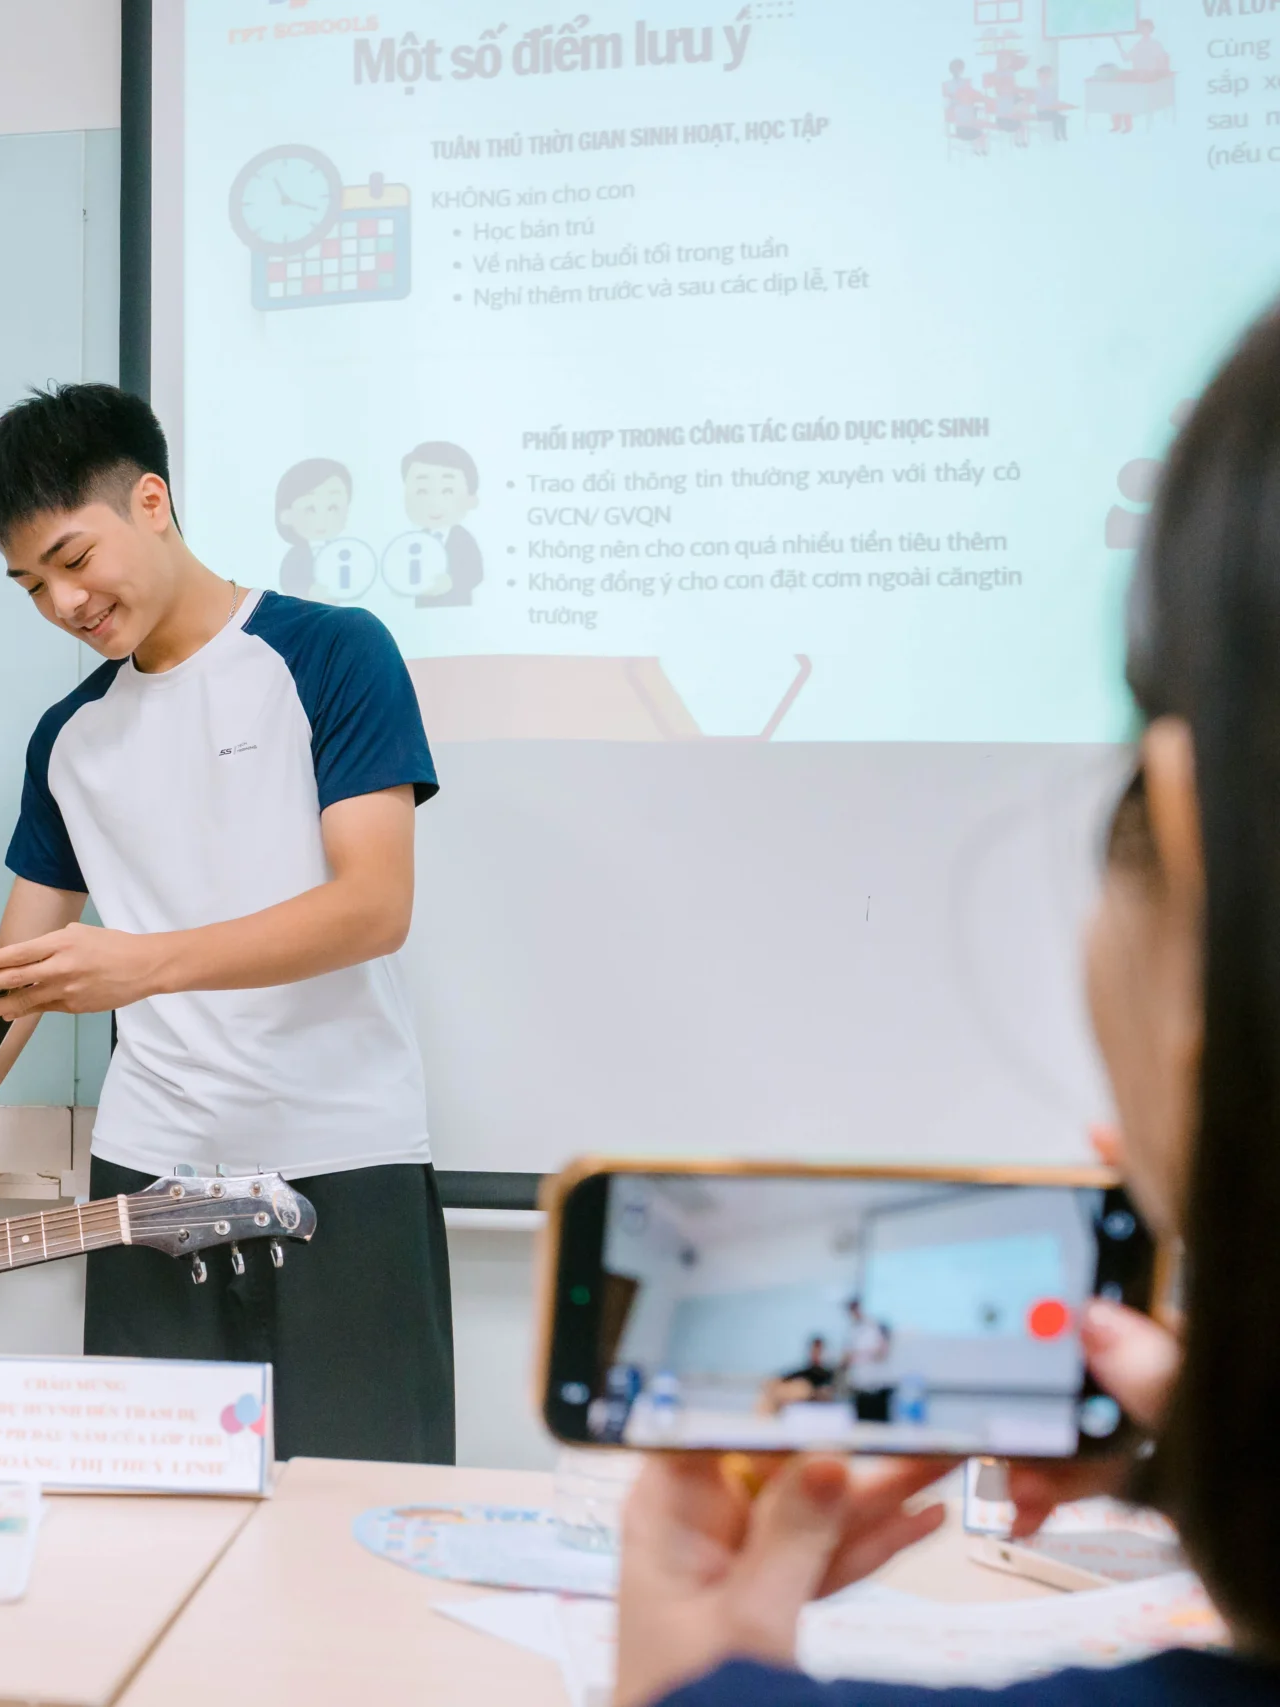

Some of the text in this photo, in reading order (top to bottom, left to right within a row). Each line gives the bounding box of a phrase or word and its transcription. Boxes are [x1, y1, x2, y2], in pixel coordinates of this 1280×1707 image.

[273, 13, 380, 39] SCHOOLS
[353, 5, 751, 95] Một số điểm lưu ý
[1207, 37, 1271, 61] Cùng
[430, 134, 480, 159] TUÂN
[528, 129, 573, 155] THỜI
[578, 127, 625, 151] GIAN
[630, 125, 678, 147] SINH
[683, 122, 740, 148] HOẠT,
[745, 120, 786, 145] HỌC
[790, 111, 830, 143] TẬP
[1207, 112, 1249, 130] sau
[1207, 140, 1261, 170] (nếu
[431, 185, 511, 208] KHÔNG
[552, 183, 591, 204] cho
[596, 183, 636, 200] con
[473, 217, 595, 242] Học bán trú
[550, 251, 587, 271] các
[591, 241, 638, 268] buổi
[643, 241, 671, 264] tối
[676, 244, 735, 265] trong
[527, 285, 582, 305] thêm
[587, 279, 643, 302] trước
[647, 278, 673, 298] và
[678, 279, 715, 296] sau
[720, 274, 758, 294] các
[763, 271, 798, 297] dịp
[803, 266, 829, 292] lễ,
[833, 266, 870, 289] Tết
[521, 416, 990, 456] PHỐI HỢP TRONG CÔNG TÁC GIÁO DỤC HỌC SINH
[526, 474, 574, 493] Trao
[582, 469, 616, 492] đổi
[624, 471, 688, 495] thông
[695, 469, 723, 488] tin
[730, 467, 810, 491] thường
[817, 464, 884, 489] xuyên
[892, 463, 926, 483] với
[993, 461, 1021, 482] cô
[527, 505, 672, 527] GVCN/ GVQN
[528, 540, 595, 564] Không
[600, 540, 640, 559] nên
[644, 538, 685, 558] cho
[689, 541, 730, 556] con
[734, 534, 777, 559] quá
[898, 532, 941, 552] tiêu
[947, 531, 1008, 552] thêm
[528, 572, 595, 597] Không
[660, 572, 672, 597] ý
[677, 570, 718, 591] cho
[723, 573, 764, 590] con
[769, 567, 807, 594] đặt
[811, 570, 861, 588] cơm
[867, 566, 931, 592] ngoài
[936, 566, 1023, 591] căngtin
[528, 606, 598, 630] trường
